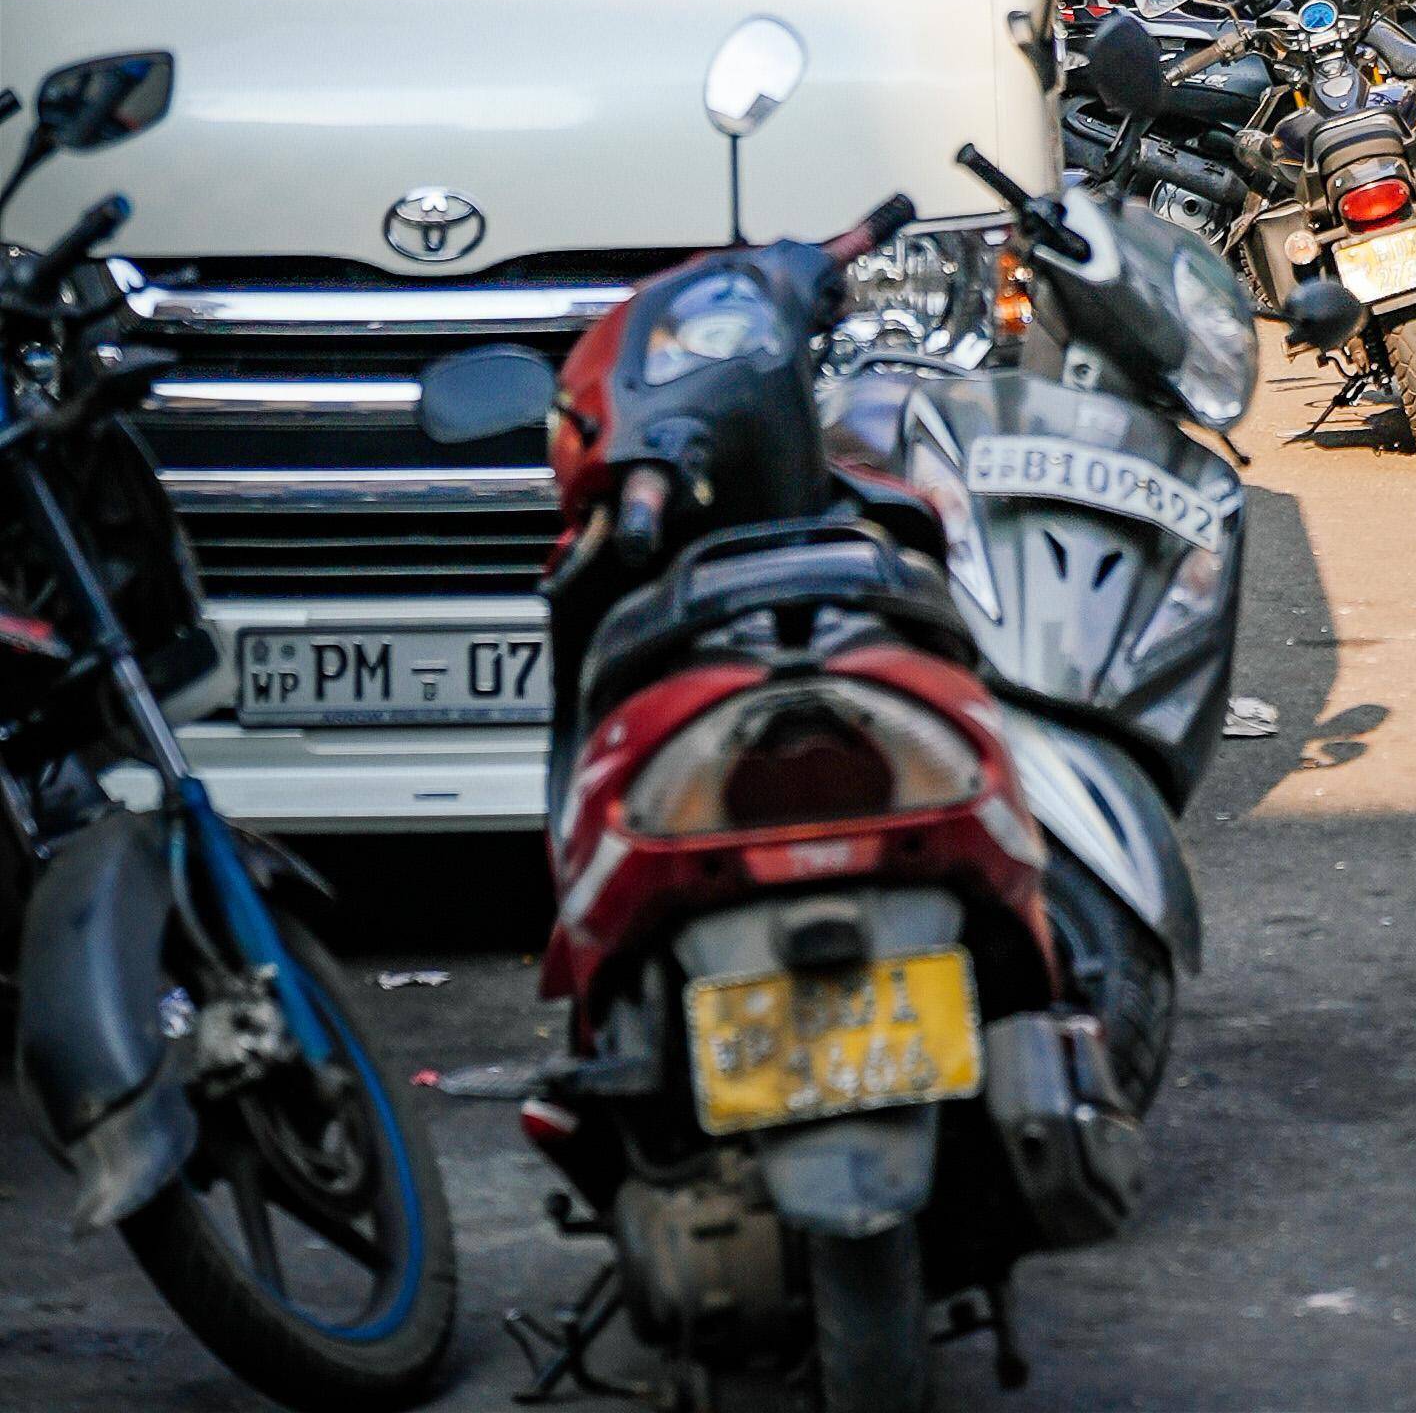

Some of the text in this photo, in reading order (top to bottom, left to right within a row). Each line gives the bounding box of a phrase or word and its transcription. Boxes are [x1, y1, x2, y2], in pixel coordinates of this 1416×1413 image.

[251, 672, 299, 704] WP
[312, 643, 392, 703] PM
[468, 641, 543, 700] 07
